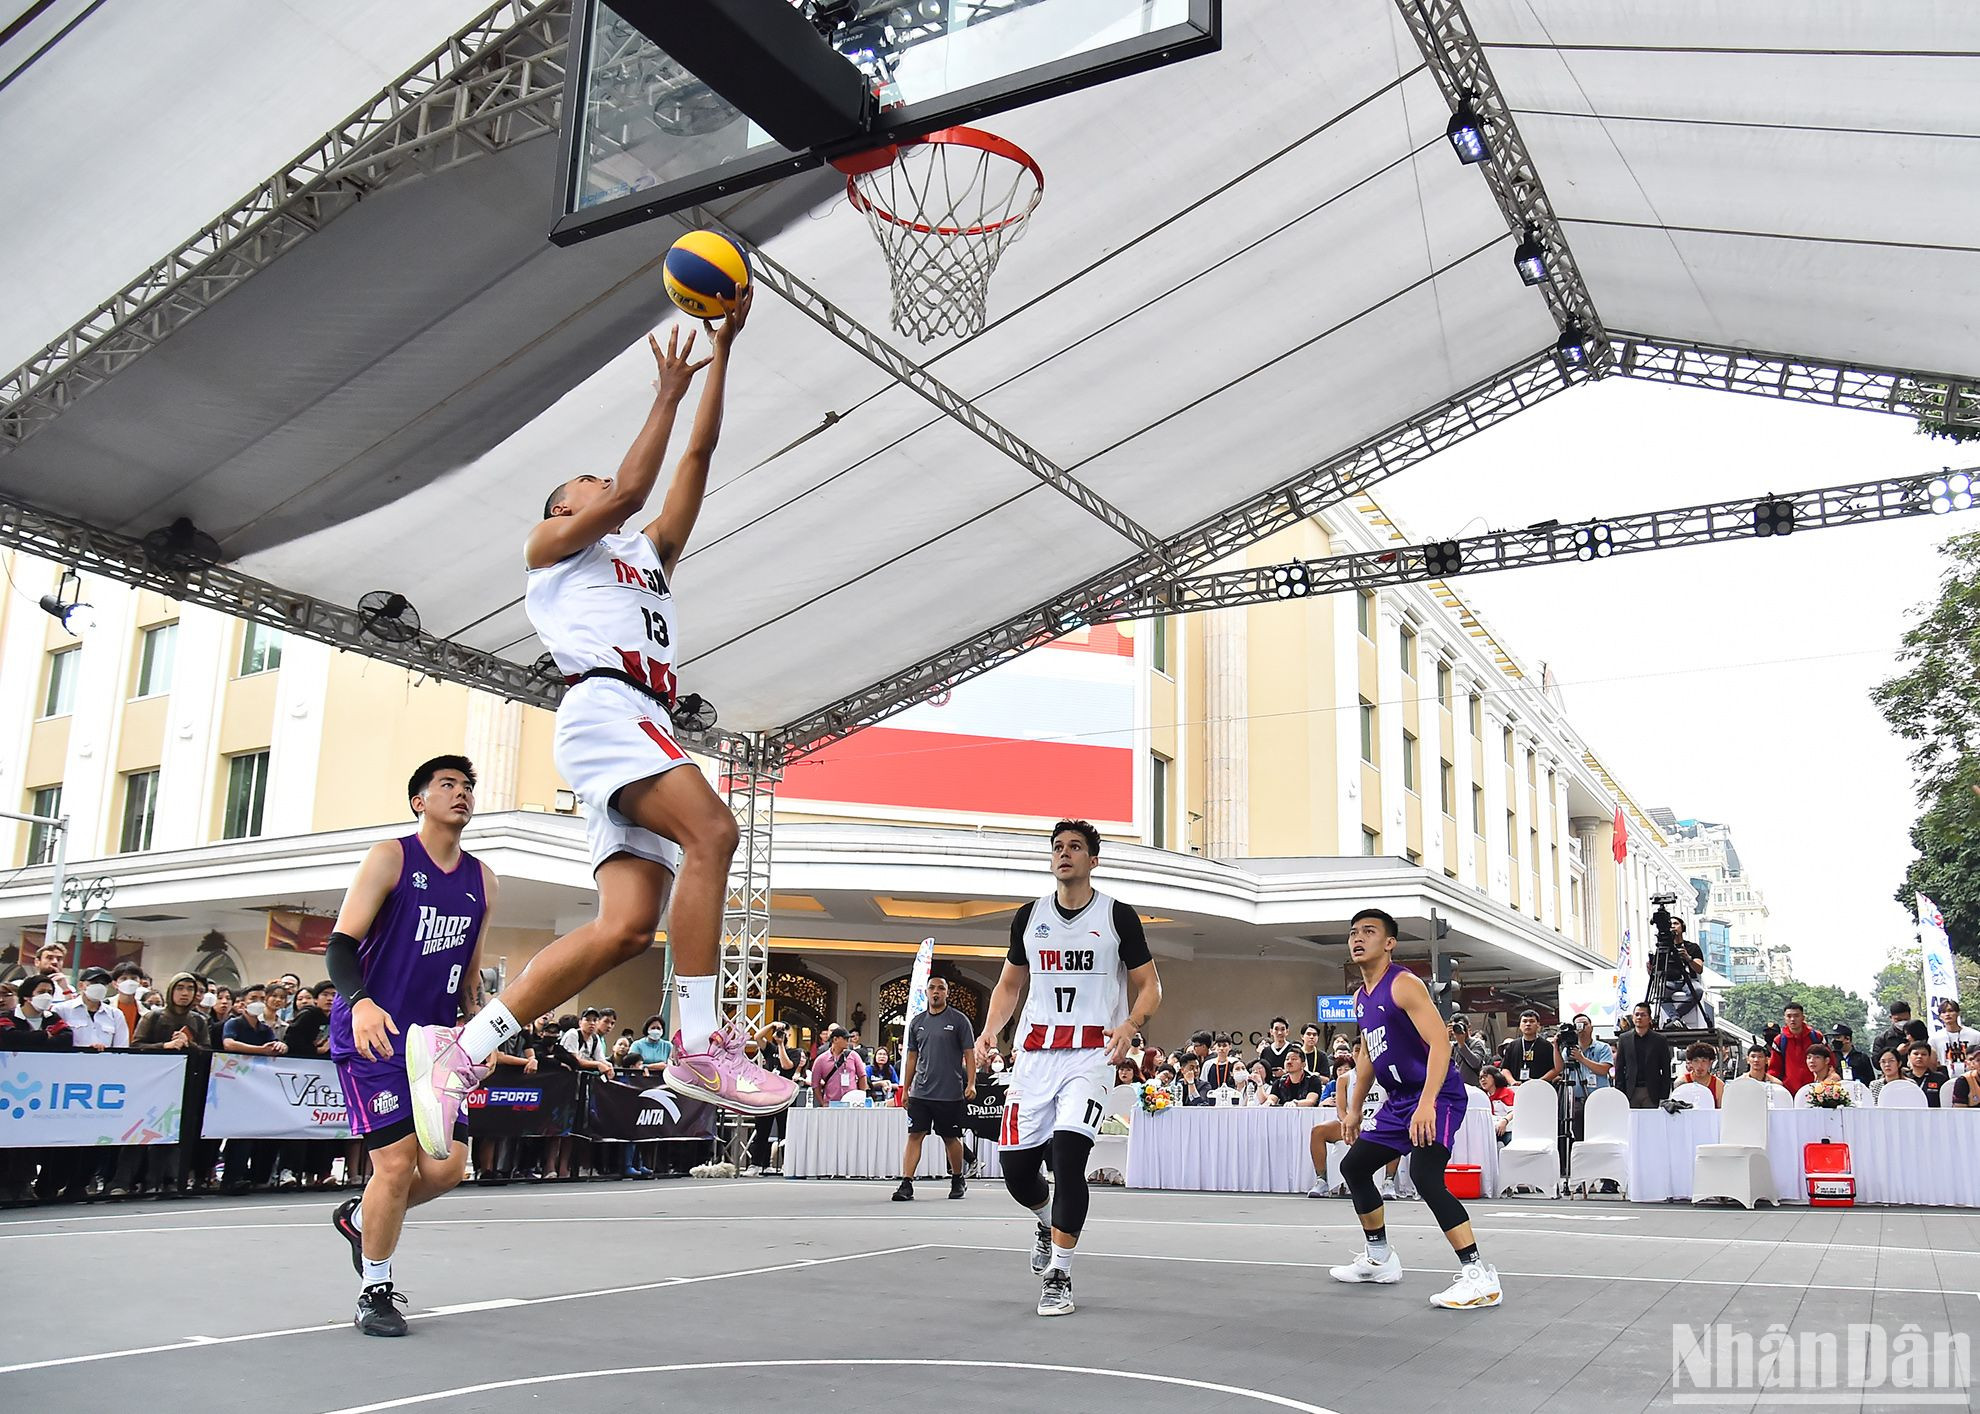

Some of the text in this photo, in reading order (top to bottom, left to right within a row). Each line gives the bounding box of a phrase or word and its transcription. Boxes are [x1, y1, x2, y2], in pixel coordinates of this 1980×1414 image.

[641, 606, 670, 648] 13
[421, 934, 467, 955] DREAMS
[446, 963, 462, 994] 8
[1054, 986, 1076, 1013] 17
[1322, 1007, 1346, 1018] TRÀNG
[1388, 1064, 1403, 1084] 1
[49, 1083, 126, 1110] IRC
[490, 1091, 539, 1102] SPORTS
[636, 1109, 664, 1126] ANTA
[1083, 1098, 1103, 1128] 17
